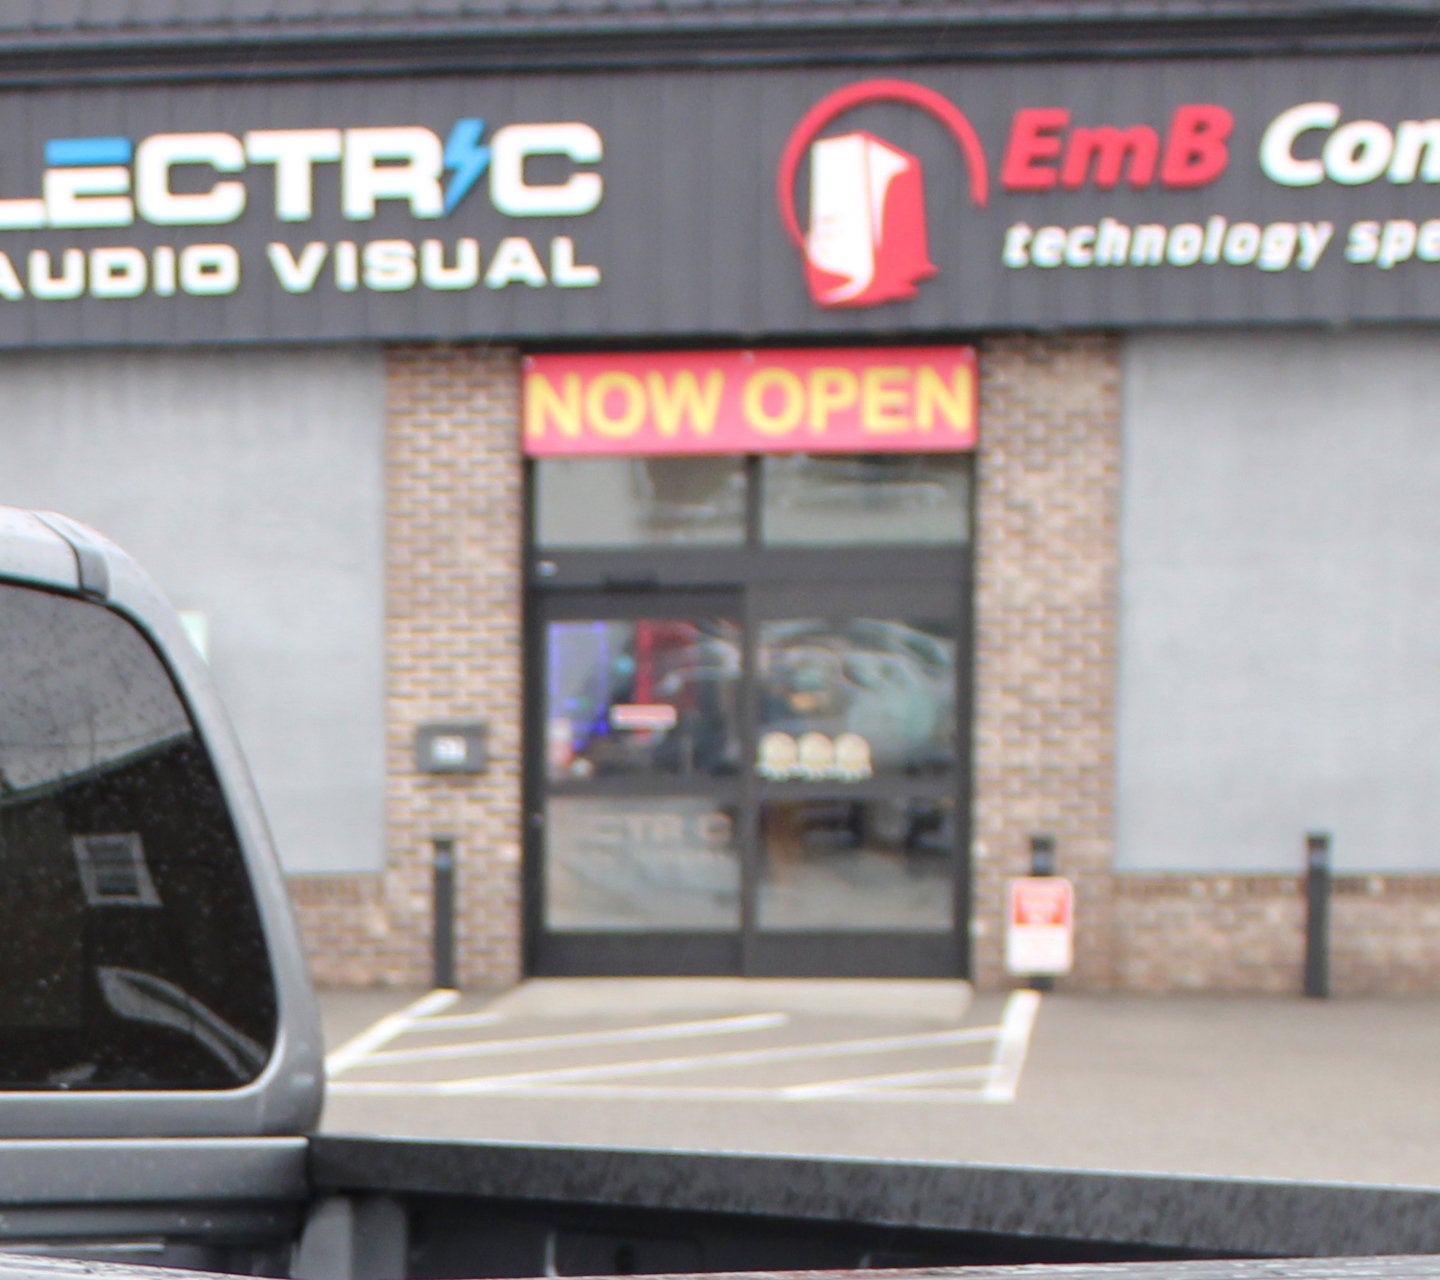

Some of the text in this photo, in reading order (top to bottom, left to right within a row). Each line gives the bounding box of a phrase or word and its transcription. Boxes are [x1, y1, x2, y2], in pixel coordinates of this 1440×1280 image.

[1000, 103, 1235, 191] EmB
[266, 235, 603, 293] VISUAL
[1002, 214, 1333, 271] technology
[526, 365, 973, 438] NOW OPEN
